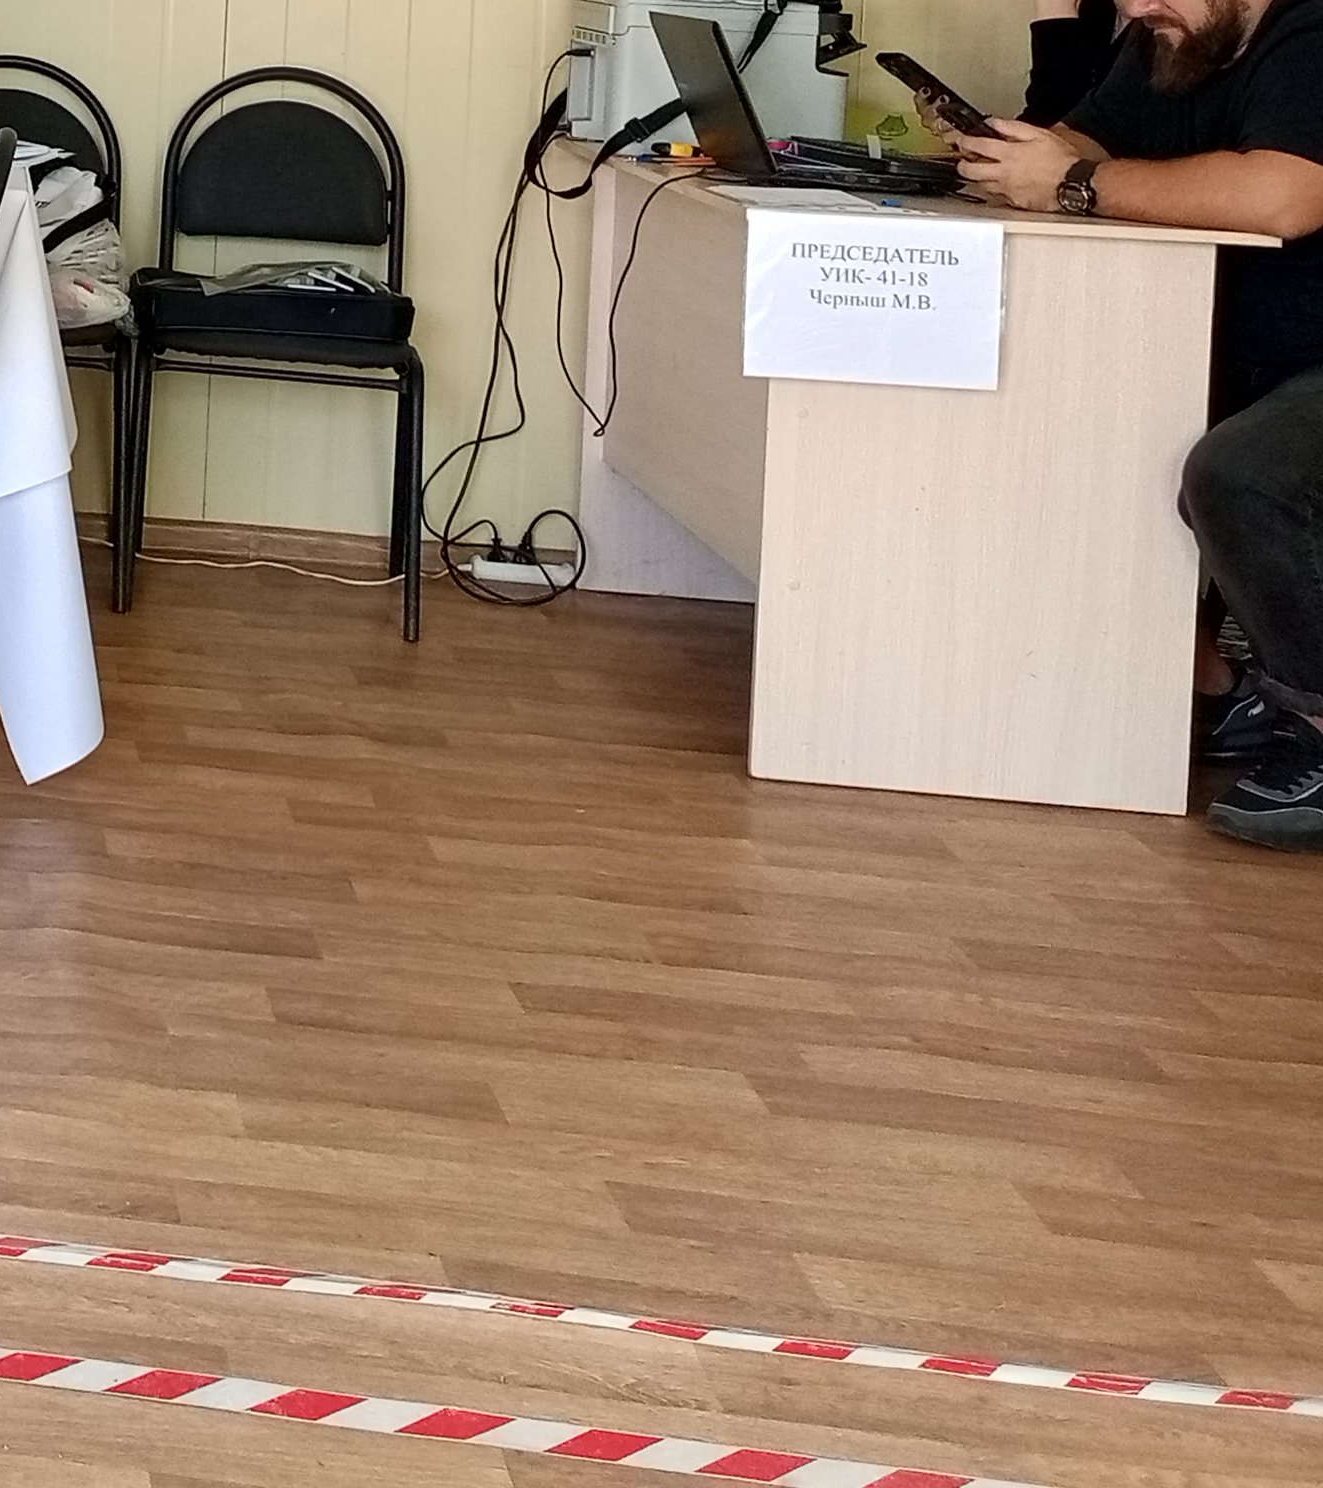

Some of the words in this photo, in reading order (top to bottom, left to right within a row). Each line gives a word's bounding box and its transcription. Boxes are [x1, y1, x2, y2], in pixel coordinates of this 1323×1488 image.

[791, 242, 959, 266] ПРЕДСЕДАТЕЛЬ
[876, 270, 929, 287] 41-18
[809, 289, 886, 310] Черныш
[891, 293, 937, 311] М.В.
